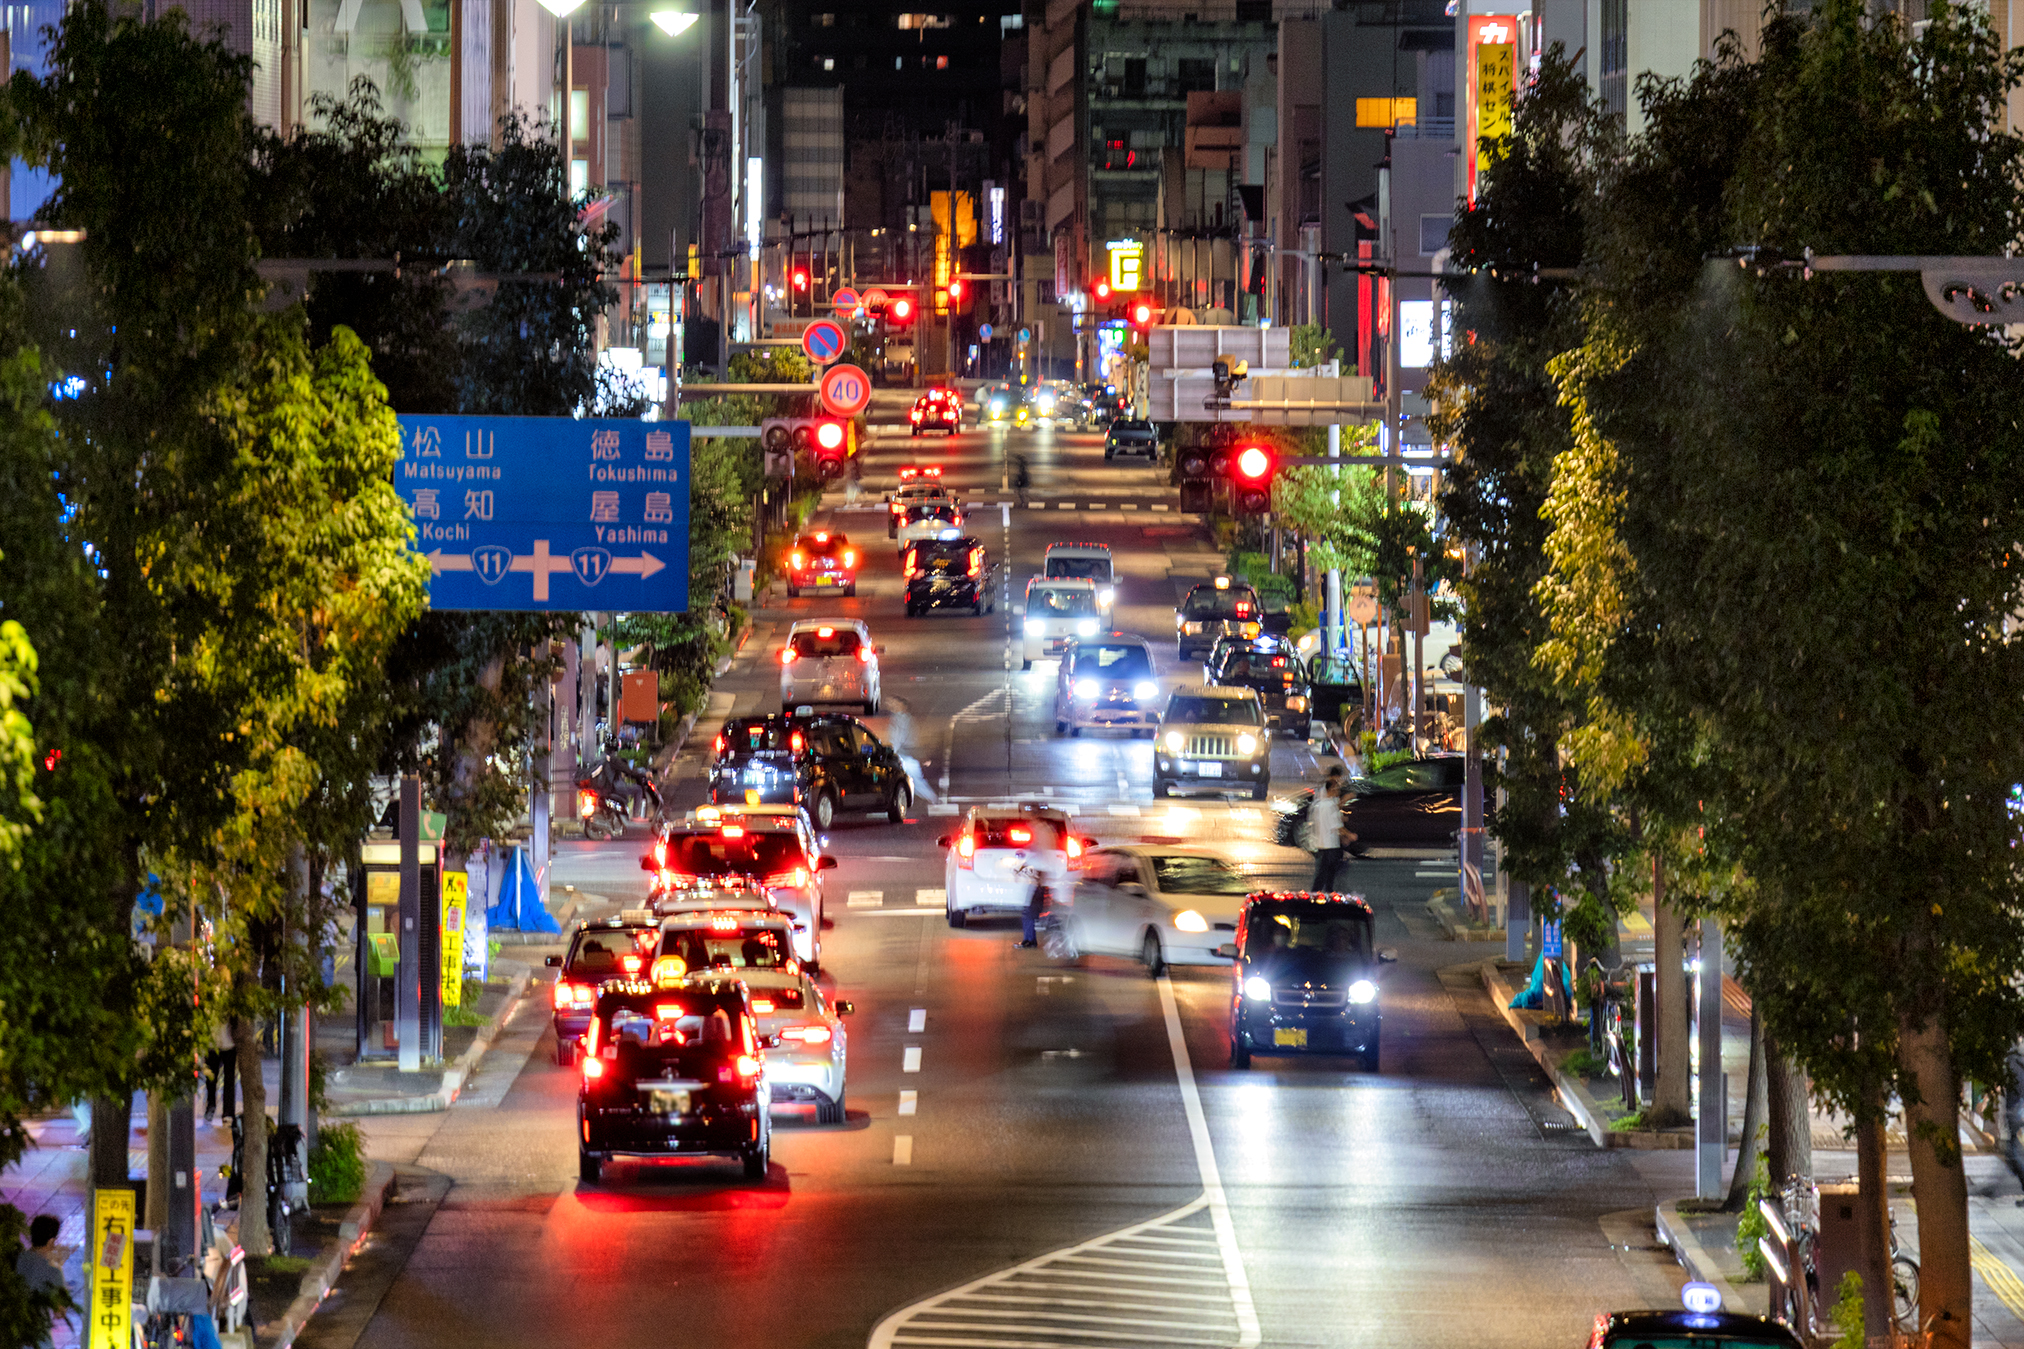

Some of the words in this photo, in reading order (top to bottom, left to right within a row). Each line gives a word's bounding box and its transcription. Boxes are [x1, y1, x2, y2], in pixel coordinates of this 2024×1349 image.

[832, 379, 859, 401] 40
[411, 425, 495, 460] 松山
[590, 428, 674, 462] 徳島
[404, 462, 501, 482] Matsuyama
[589, 464, 678, 482] Tokushima
[411, 488, 494, 521] 高知
[590, 490, 673, 524] 屋島
[422, 522, 470, 541] Kochi
[595, 524, 668, 544] Yashima
[479, 552, 501, 575] 11
[578, 554, 601, 576] 11
[100, 1200, 131, 1211] この先
